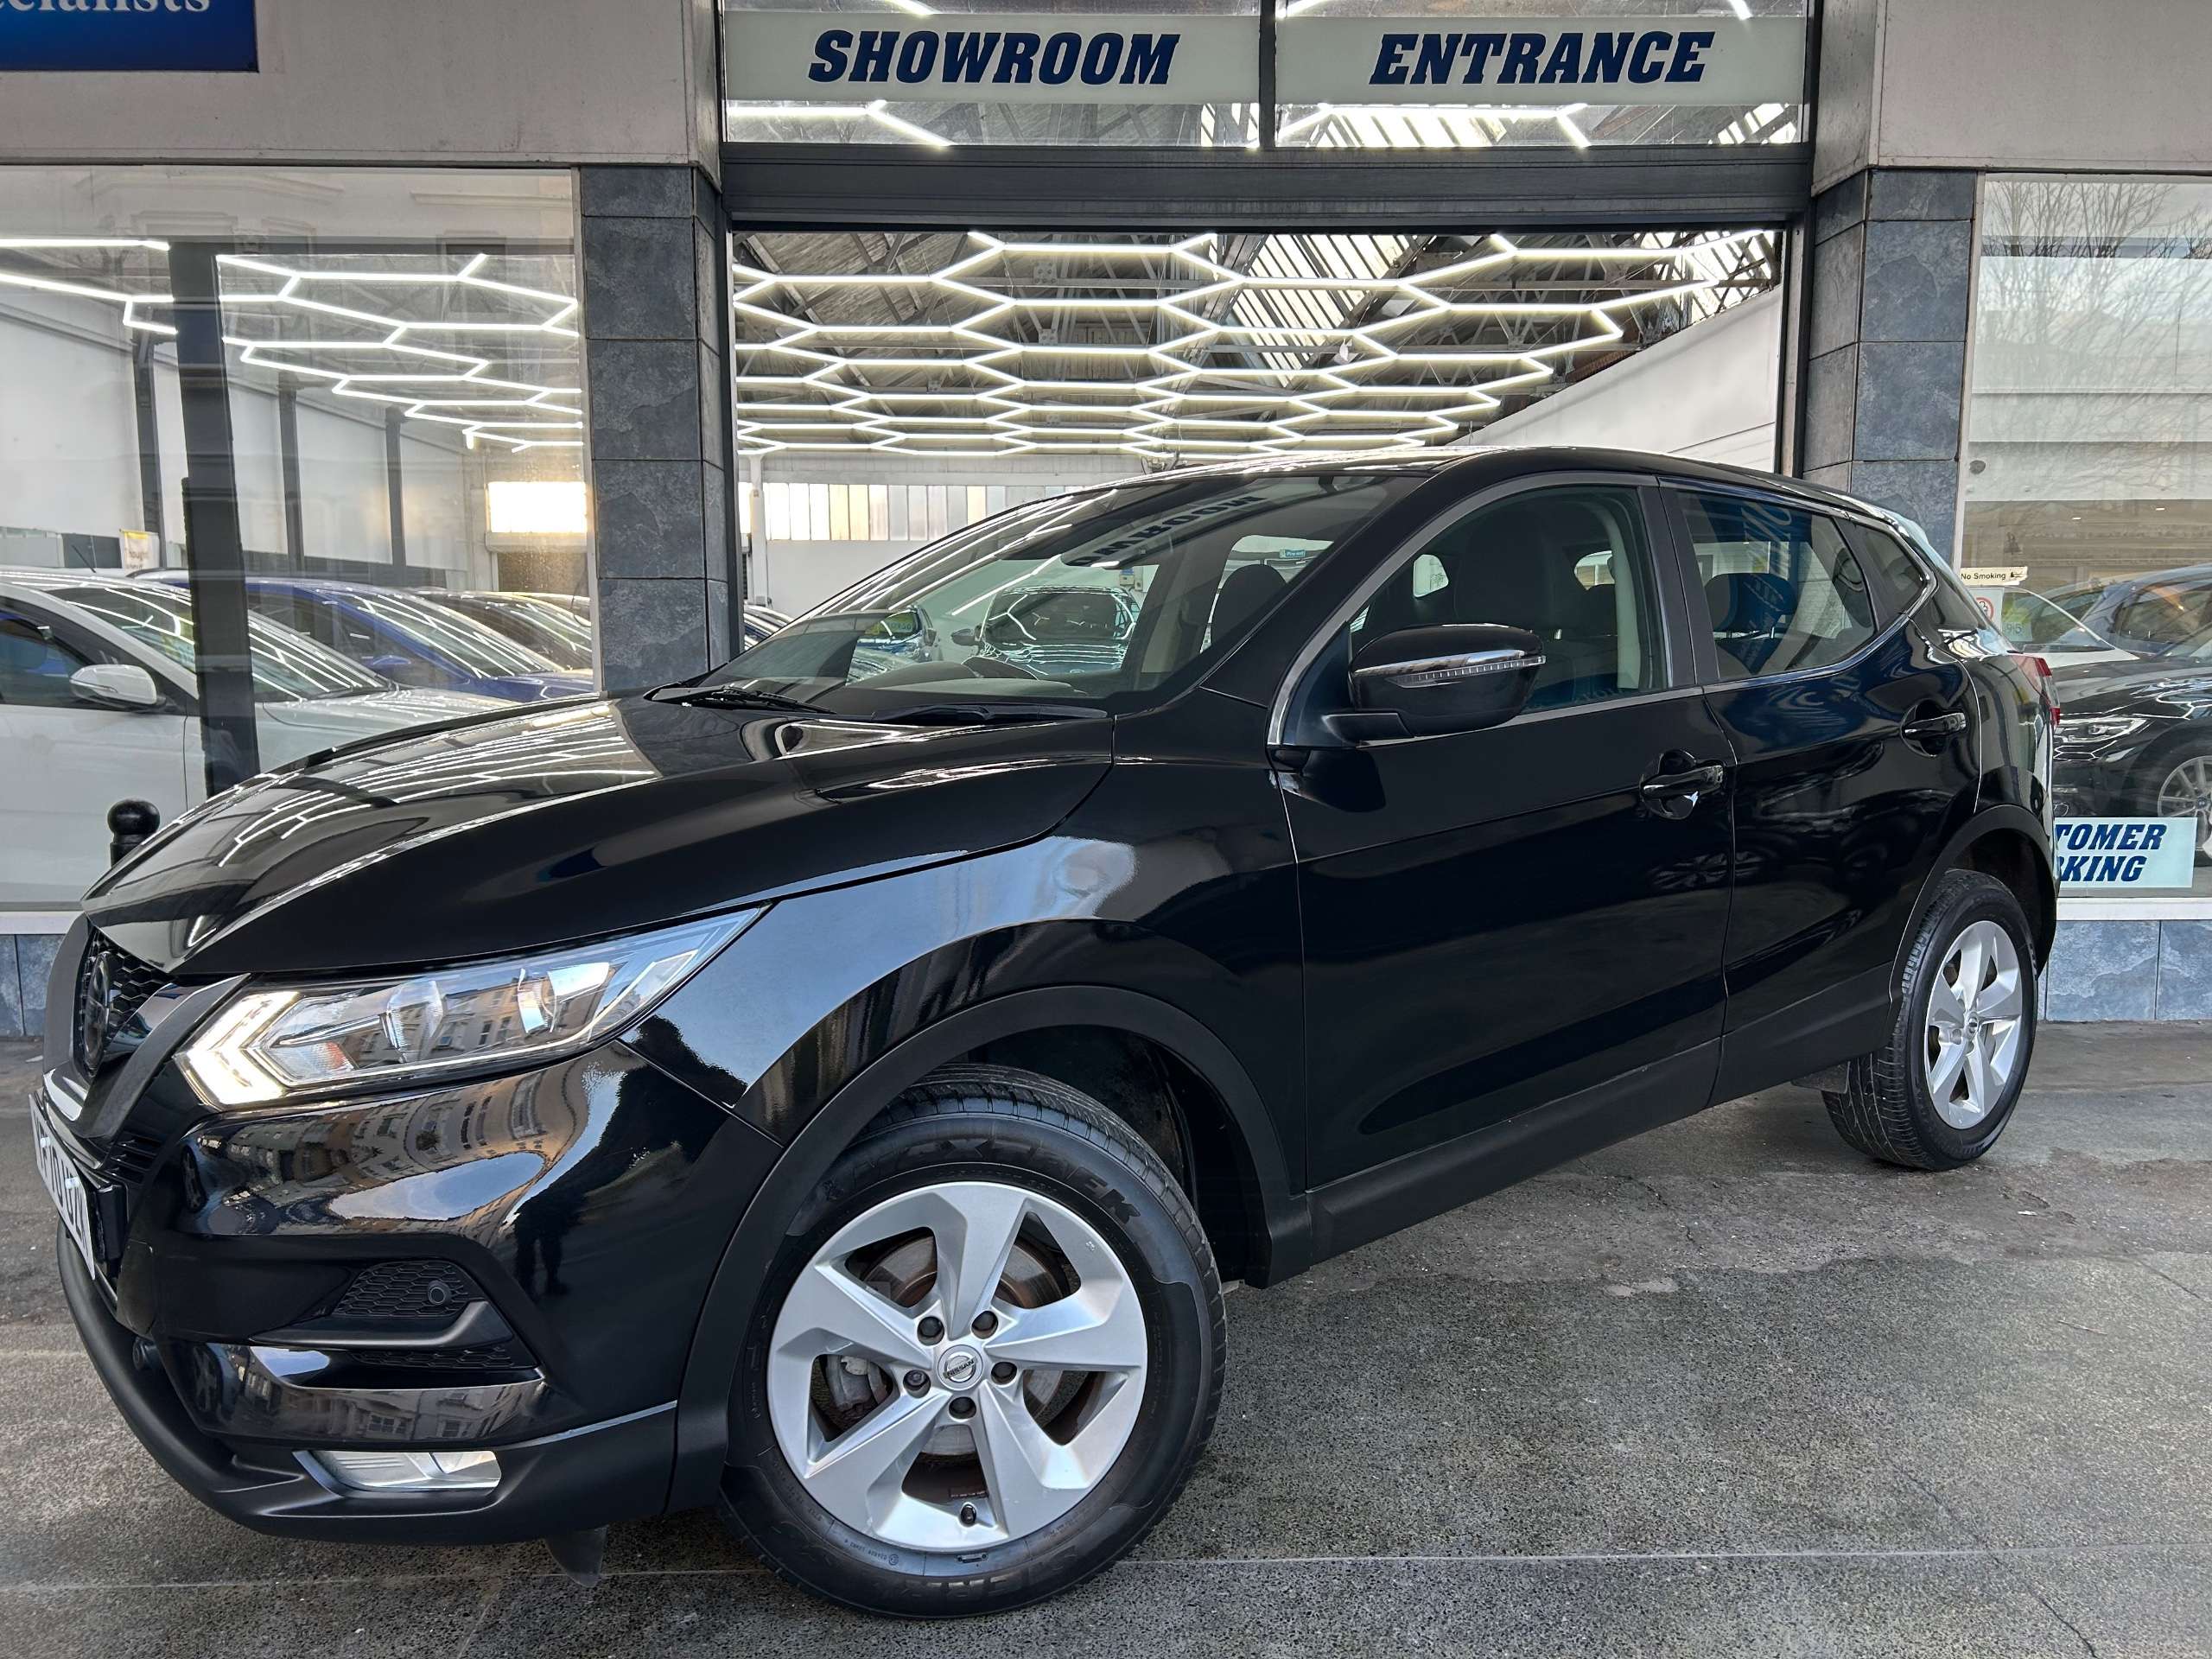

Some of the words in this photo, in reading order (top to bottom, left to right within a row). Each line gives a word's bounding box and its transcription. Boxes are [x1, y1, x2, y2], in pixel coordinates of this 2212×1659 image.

[808, 29, 1181, 85] SHOWROOM
[1369, 30, 1716, 85] ENTRANCE
[1974, 572, 2006, 581] Smoking
